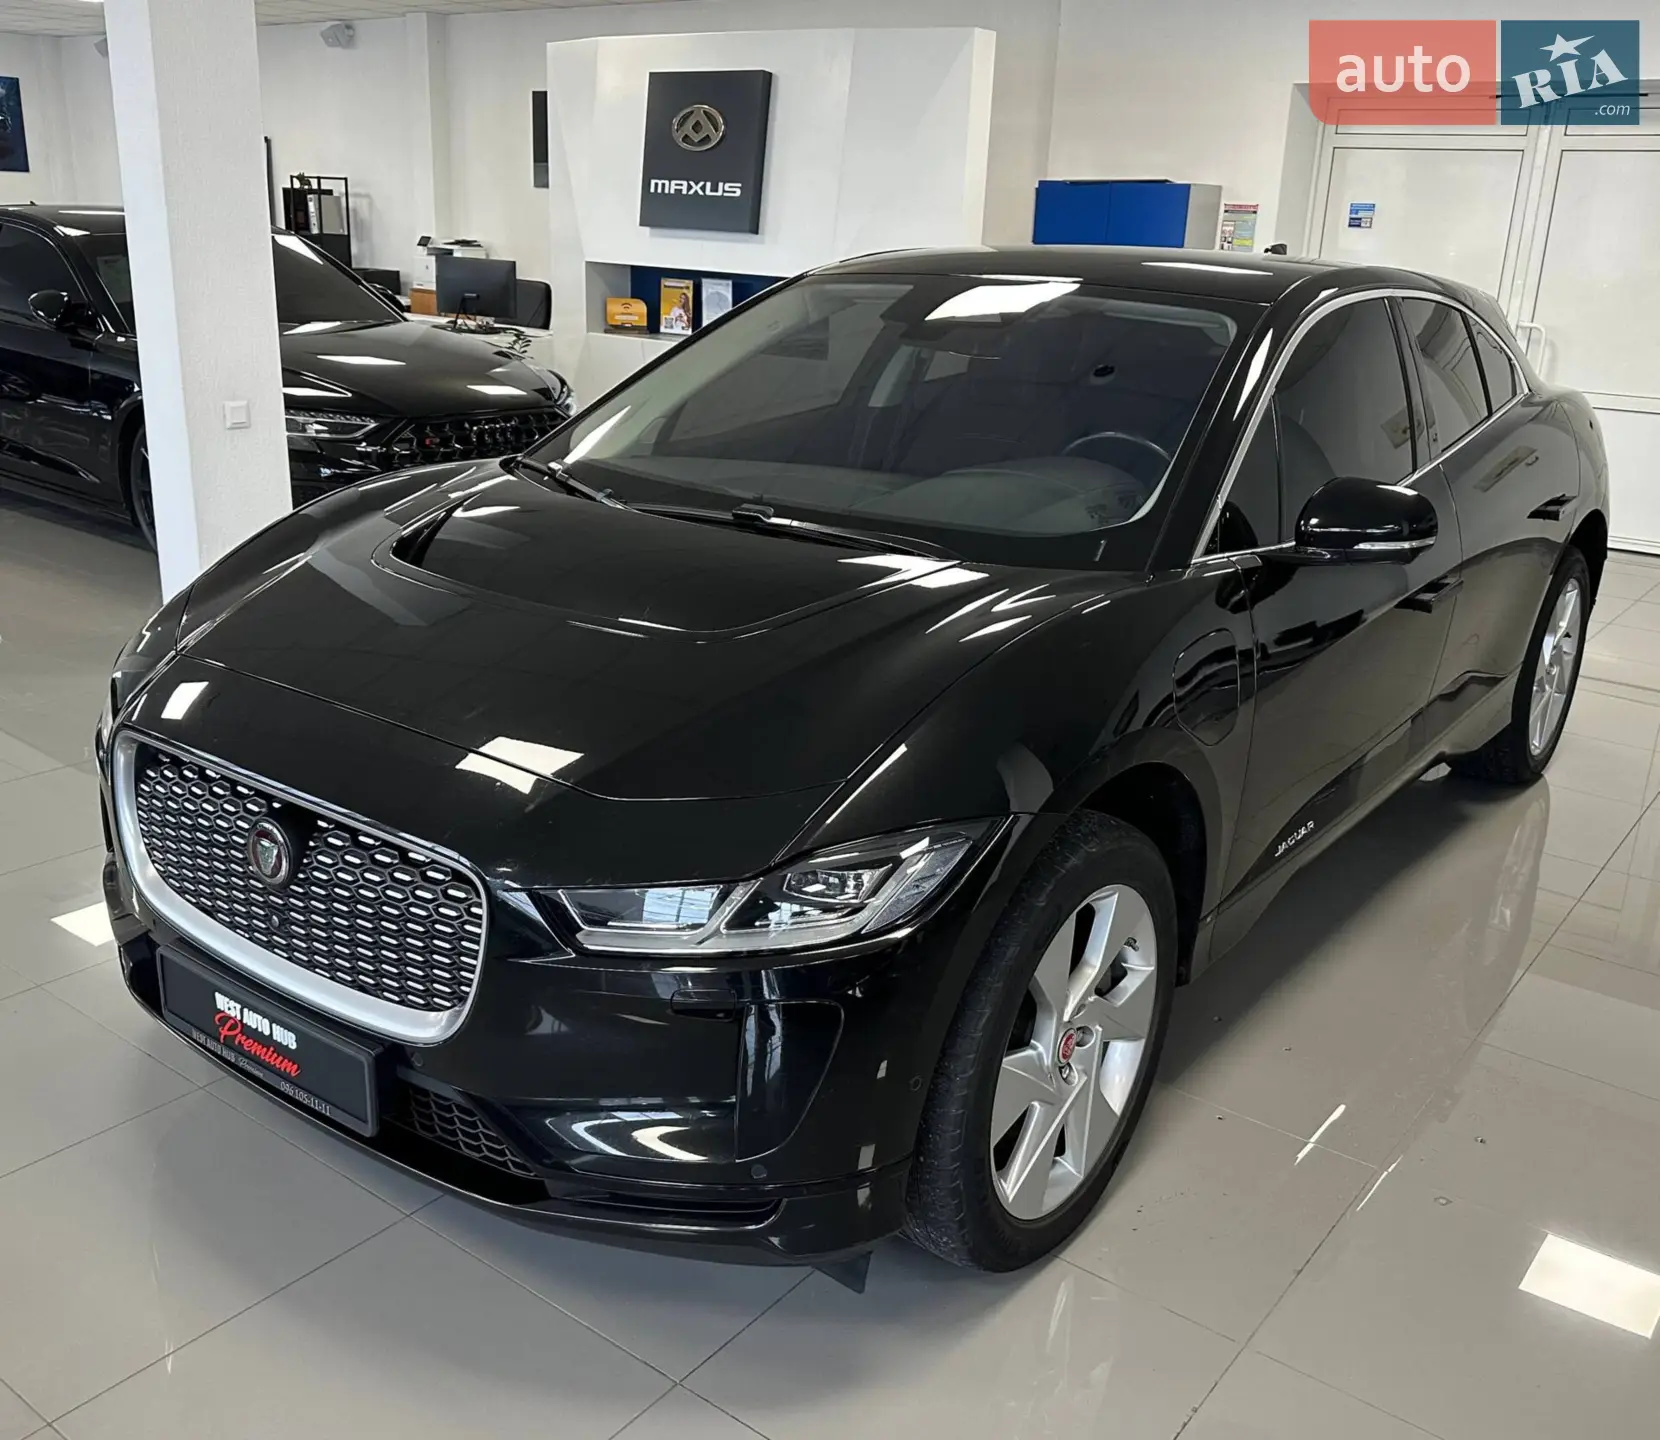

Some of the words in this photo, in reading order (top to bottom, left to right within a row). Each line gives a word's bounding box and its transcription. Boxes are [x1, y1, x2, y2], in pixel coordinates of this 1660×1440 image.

[650, 179, 742, 197] MAXUS
[1274, 820, 1315, 857] JAGUAR
[214, 991, 242, 1019] WEST
[243, 1008, 270, 1036] AUTO
[272, 1023, 297, 1049] HUB
[192, 1029, 207, 1044] WEST
[206, 1037, 222, 1054] AUTO
[222, 1046, 236, 1063] HUB
[214, 1012, 301, 1078] Premium
